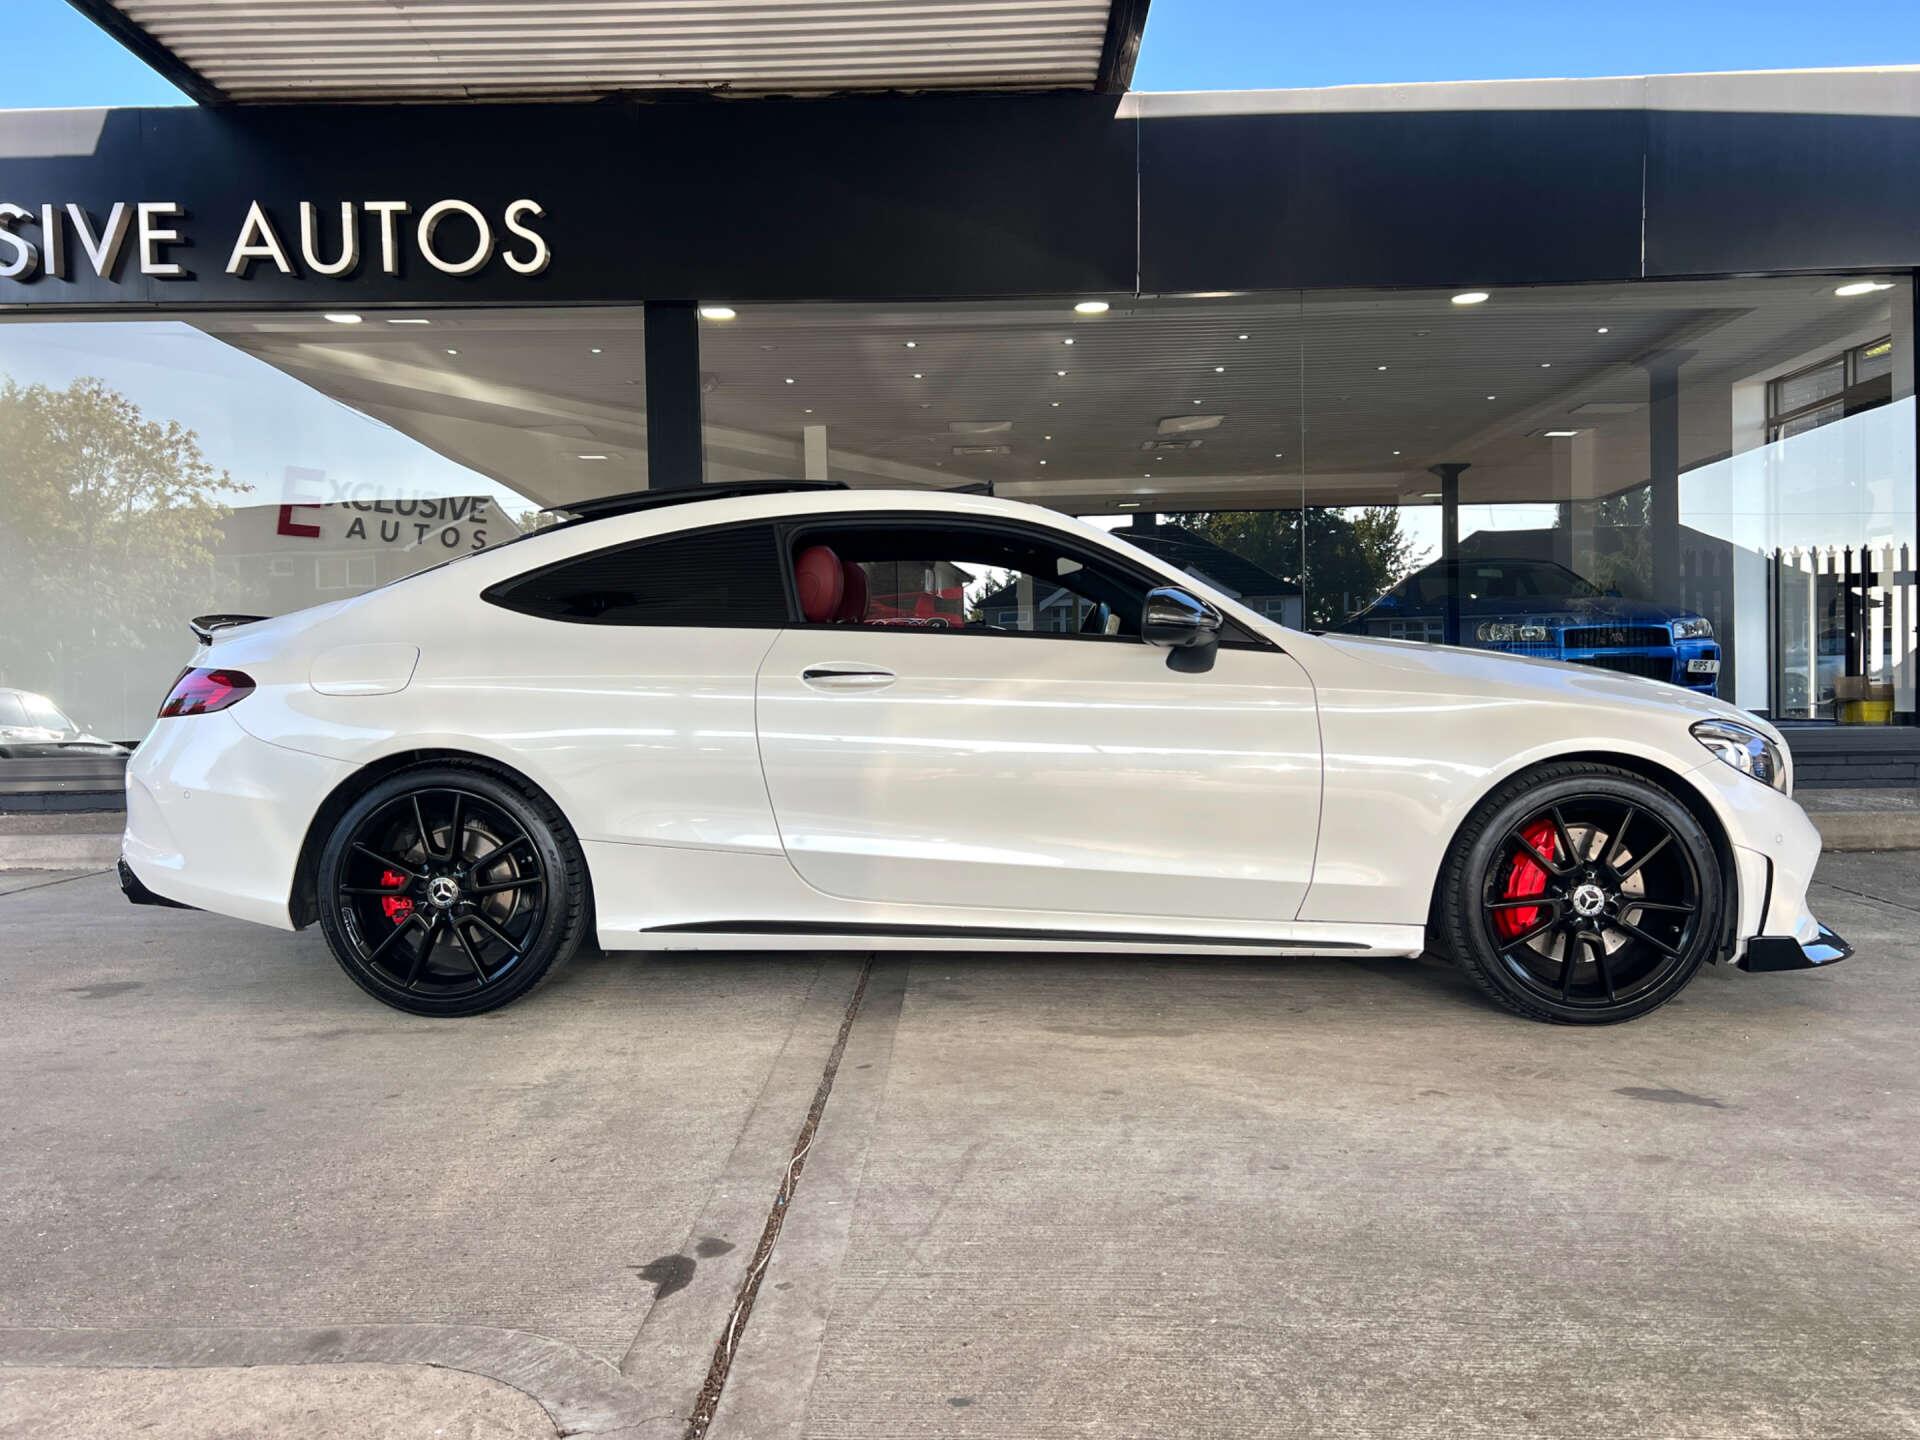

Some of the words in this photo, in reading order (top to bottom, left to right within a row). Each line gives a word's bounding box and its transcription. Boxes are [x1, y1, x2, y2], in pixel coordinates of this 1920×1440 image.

[0, 201, 187, 279] SIVE
[225, 199, 551, 277] AUTOS
[277, 465, 490, 538] EXCLUSIVE
[346, 517, 487, 551] AUTOS
